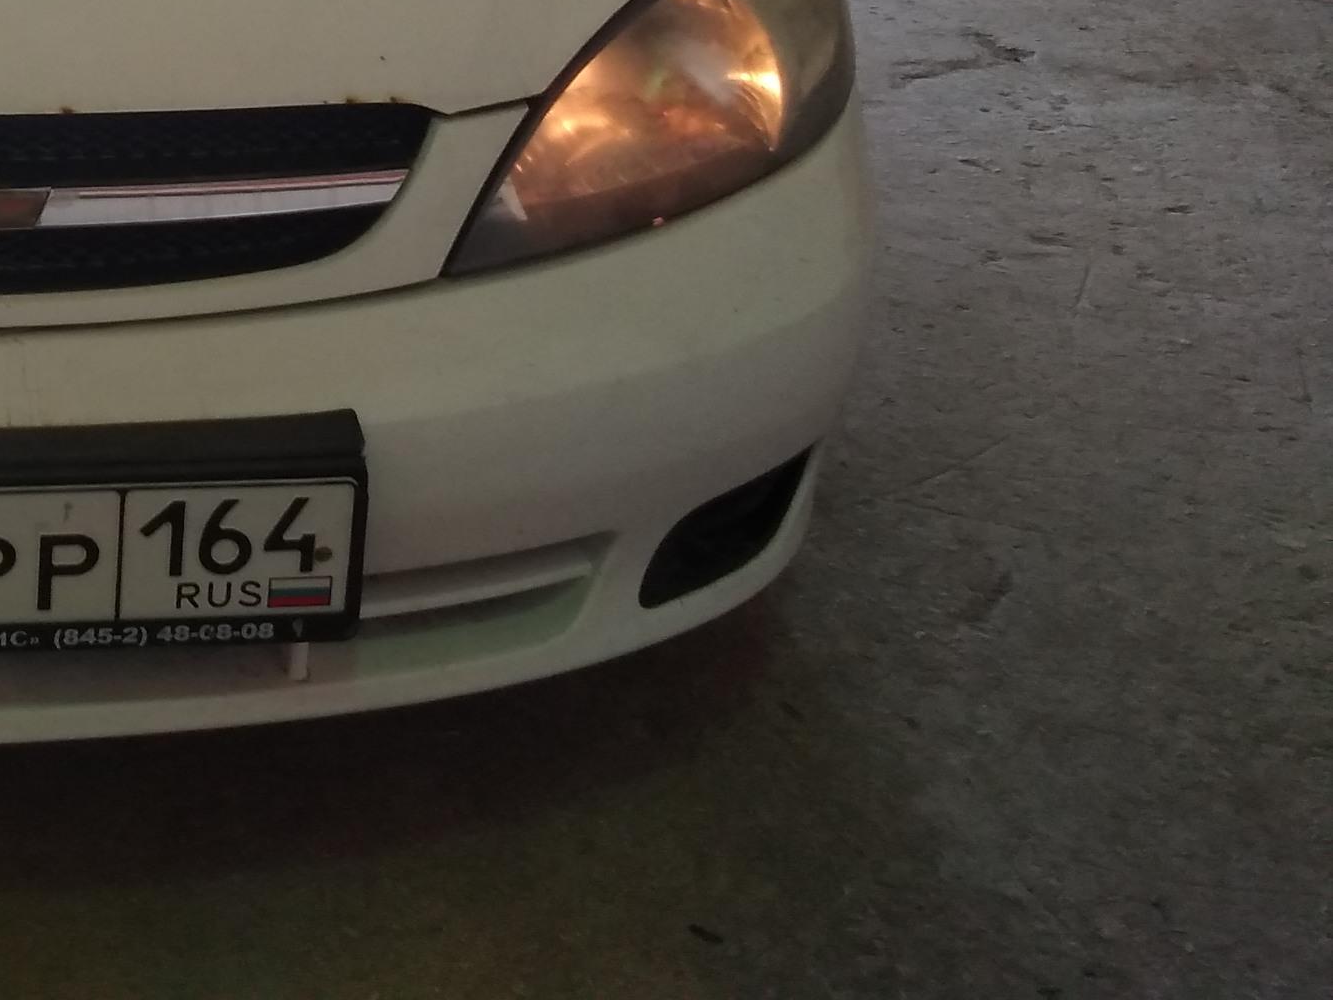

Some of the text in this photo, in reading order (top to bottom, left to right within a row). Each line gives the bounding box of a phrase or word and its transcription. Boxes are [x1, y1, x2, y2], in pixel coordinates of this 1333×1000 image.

[140, 497, 316, 577] 164
[175, 580, 263, 609] RUS
[53, 626, 148, 651] (845-2)
